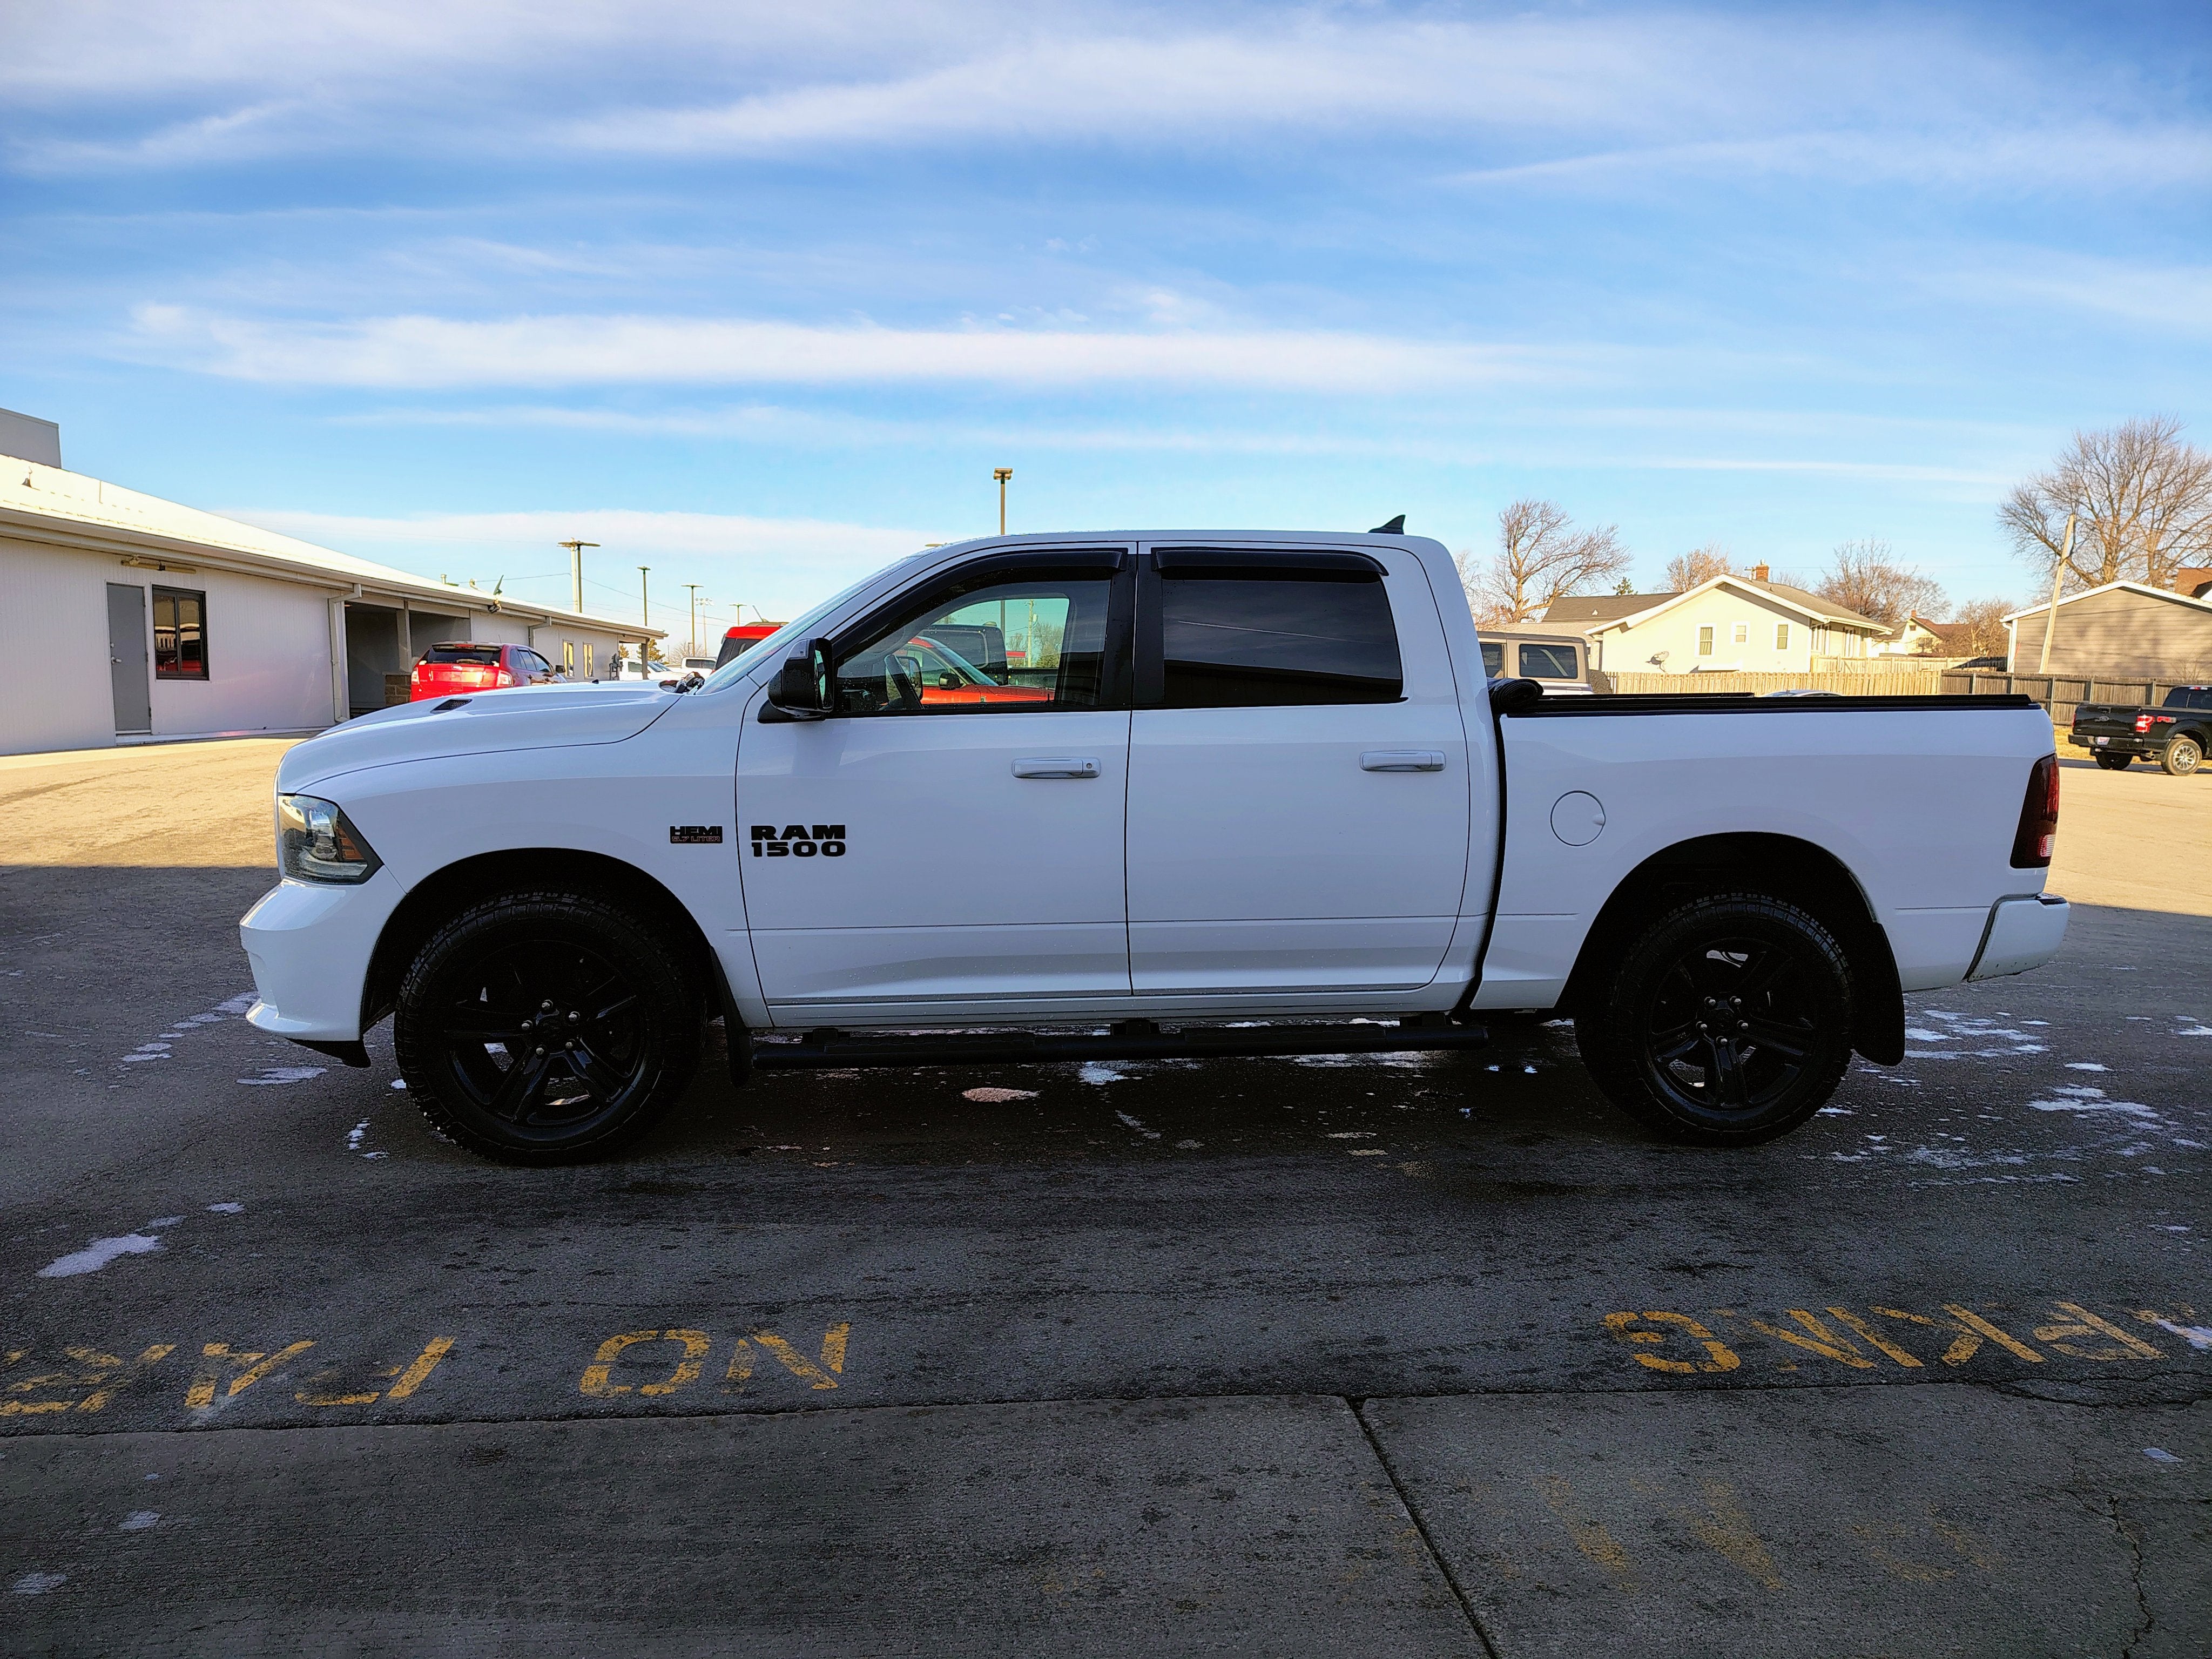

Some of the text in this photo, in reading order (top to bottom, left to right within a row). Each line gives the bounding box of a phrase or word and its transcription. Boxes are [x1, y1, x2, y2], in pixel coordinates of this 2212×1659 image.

[670, 826, 723, 835] HEMI
[751, 825, 845, 840] RAM
[751, 841, 846, 857] 1500
[0, 1322, 852, 1416] NO PAR
